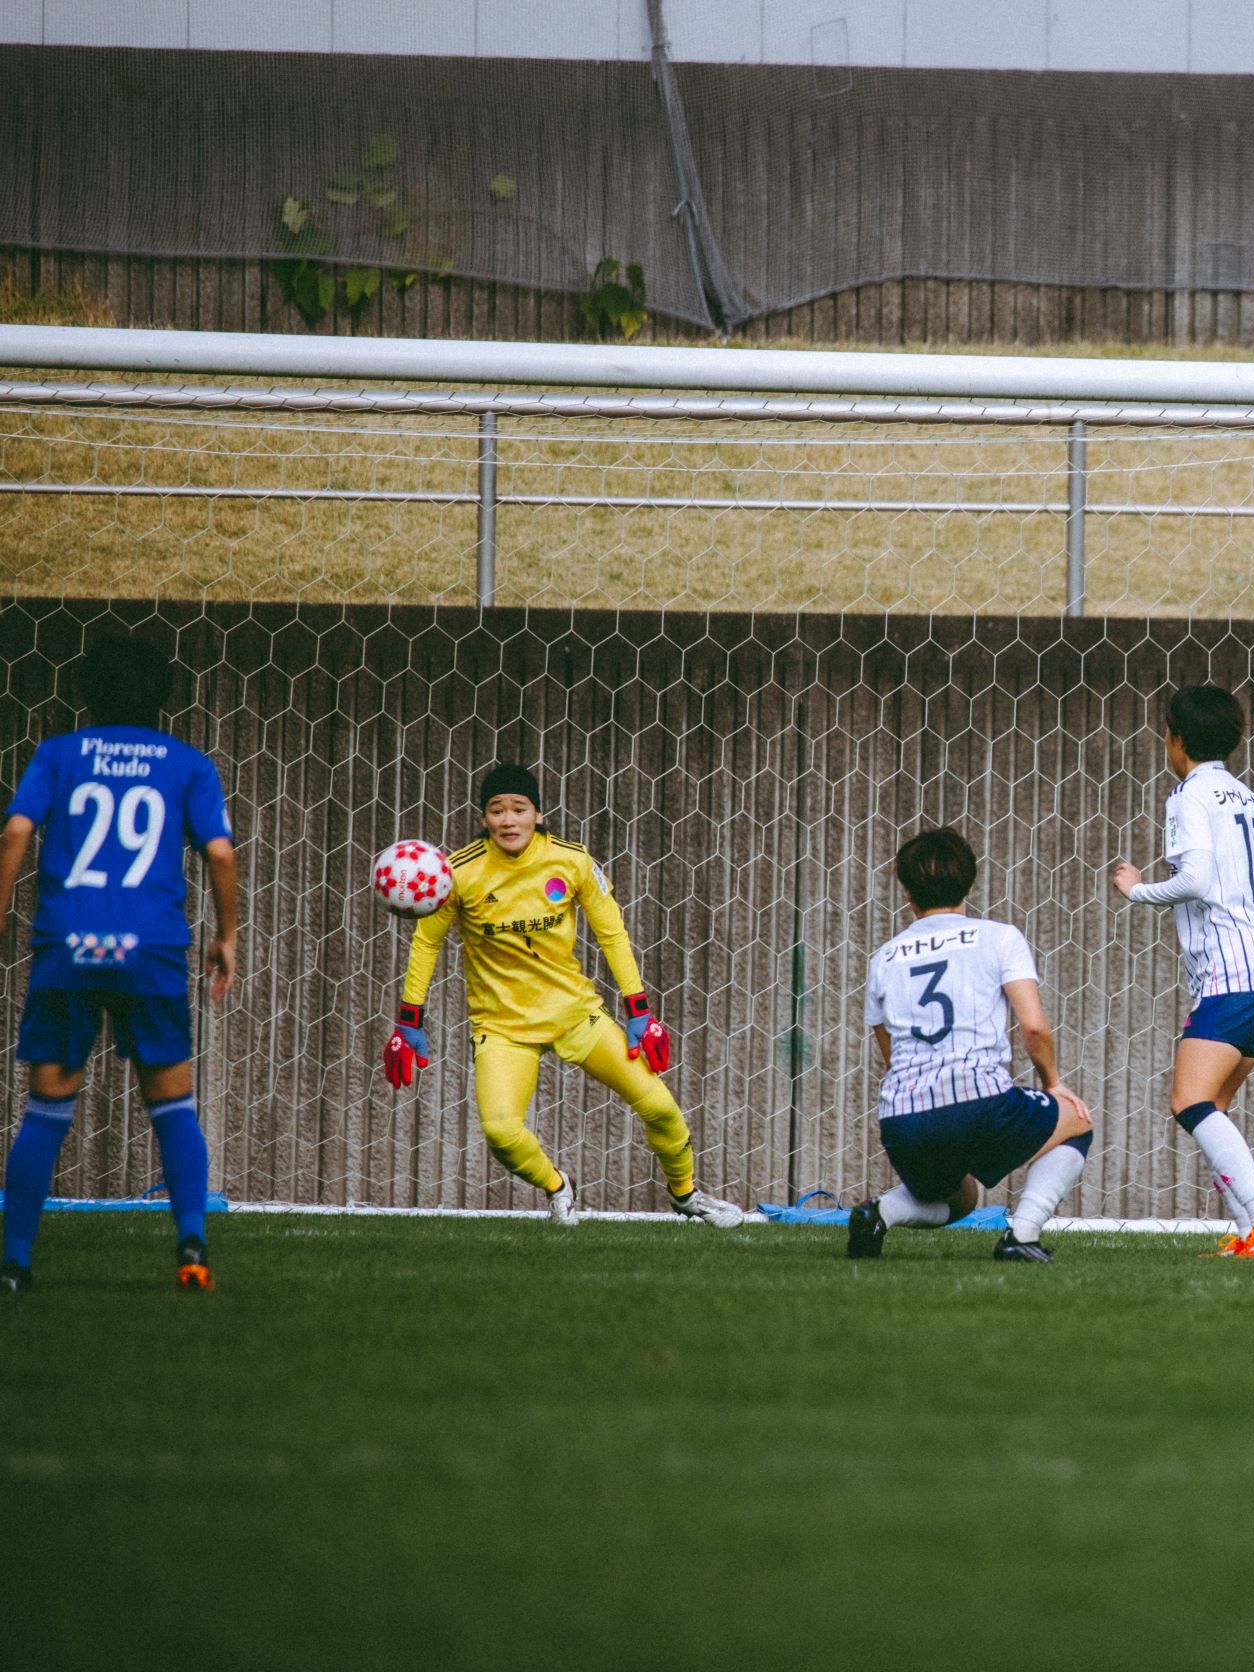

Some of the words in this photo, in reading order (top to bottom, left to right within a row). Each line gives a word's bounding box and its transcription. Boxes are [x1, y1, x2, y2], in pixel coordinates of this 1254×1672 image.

[81, 737, 168, 759] Florence
[93, 755, 151, 777] Kudo
[64, 782, 166, 888] 29
[885, 929, 978, 962] シャトレーゼ
[910, 960, 953, 1044] 3
